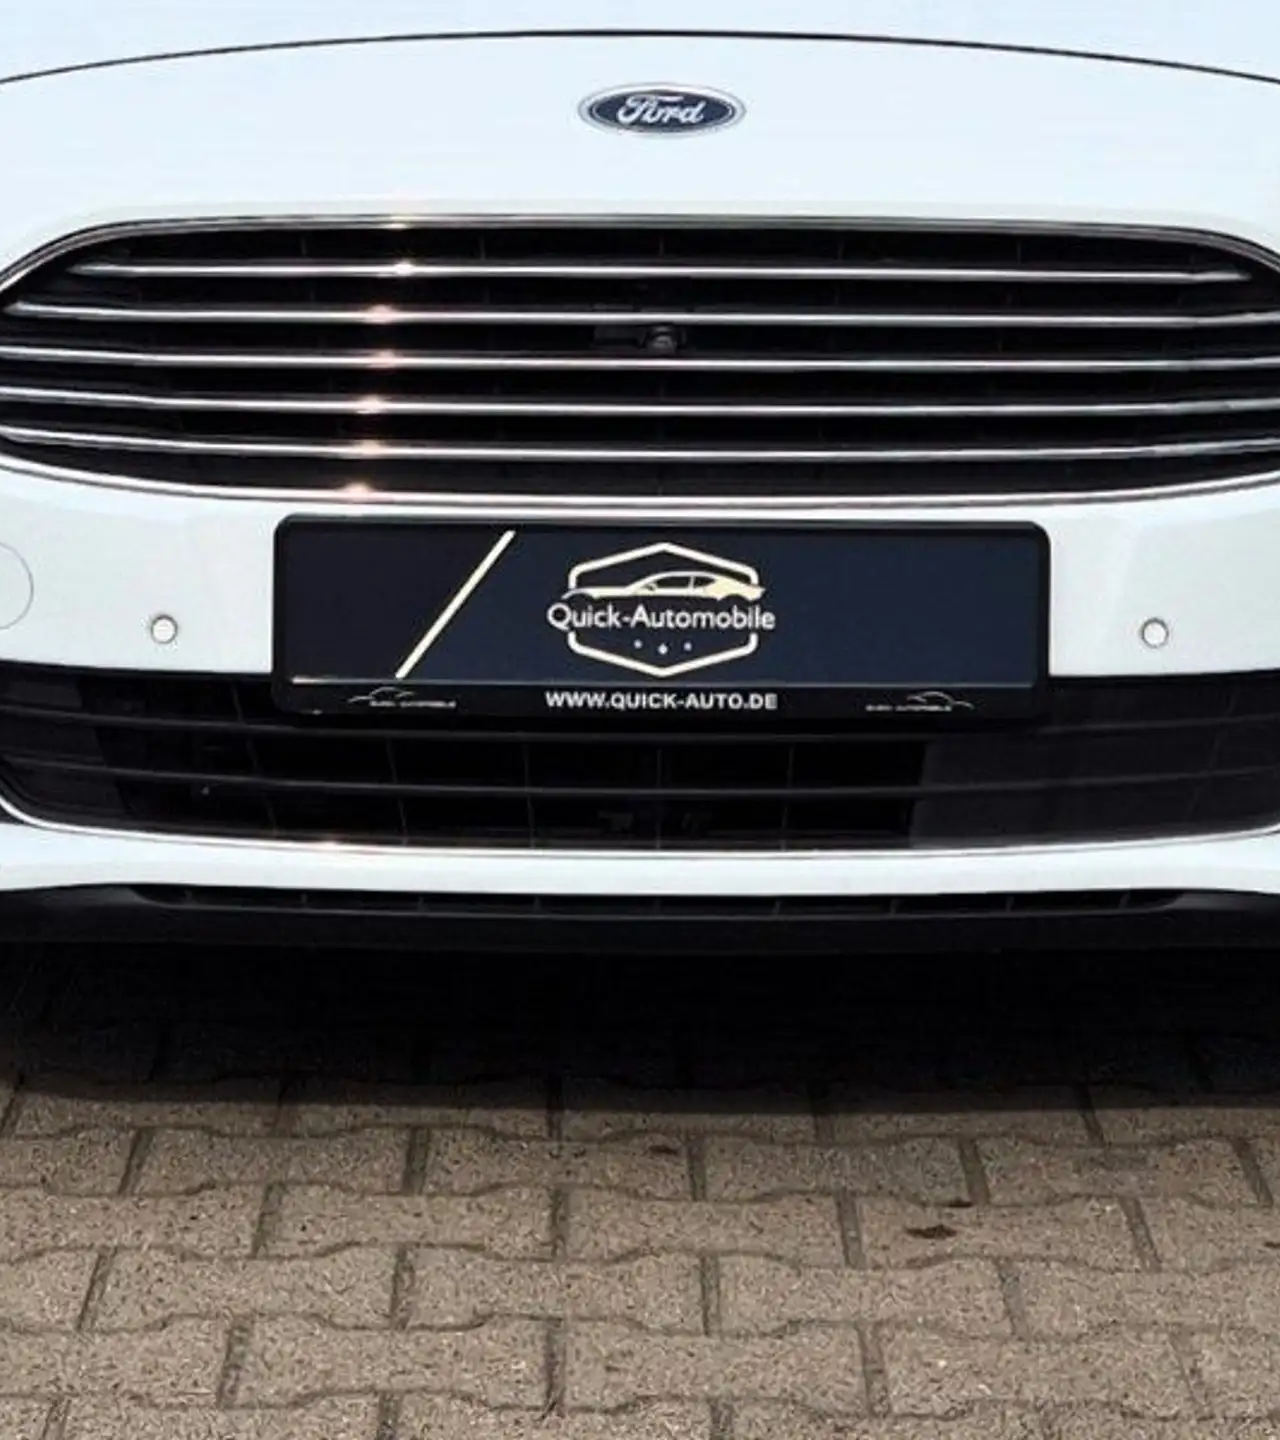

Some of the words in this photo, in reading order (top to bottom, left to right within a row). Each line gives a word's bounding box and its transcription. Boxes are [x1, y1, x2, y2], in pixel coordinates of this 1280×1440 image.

[616, 94, 707, 125] Ford
[547, 603, 776, 630] Quick-Automobile
[545, 691, 778, 710] WWW.QUICK-AUTO.DE
